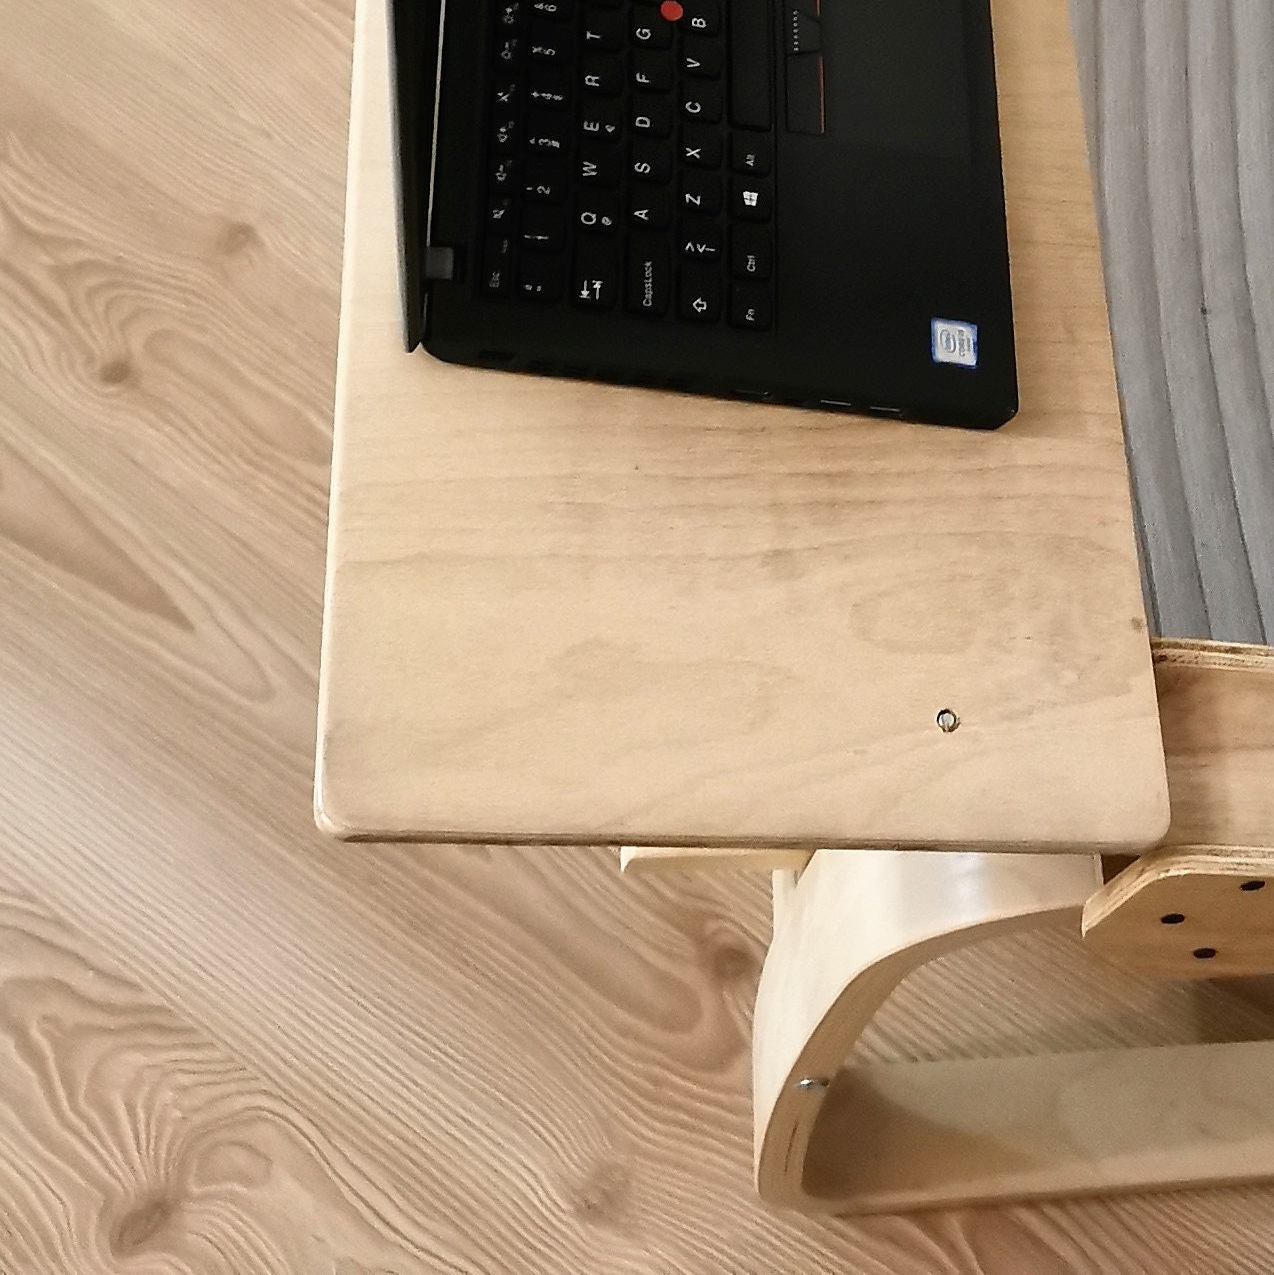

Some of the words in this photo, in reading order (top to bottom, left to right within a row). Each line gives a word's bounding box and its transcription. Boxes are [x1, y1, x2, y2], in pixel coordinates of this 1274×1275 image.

[691, 18, 706, 29] B
[586, 31, 602, 39] T
[636, 28, 651, 40] G
[685, 58, 700, 68] V
[585, 75, 600, 86] R
[635, 72, 651, 83] F
[685, 101, 701, 113] C
[583, 121, 600, 132] E
[635, 117, 653, 128] D
[685, 148, 702, 159] X
[582, 161, 597, 176] W
[633, 163, 650, 174] S
[685, 193, 701, 206] Z
[580, 211, 597, 225] Q
[633, 209, 650, 220] A
[641, 262, 654, 306] CapsLock
